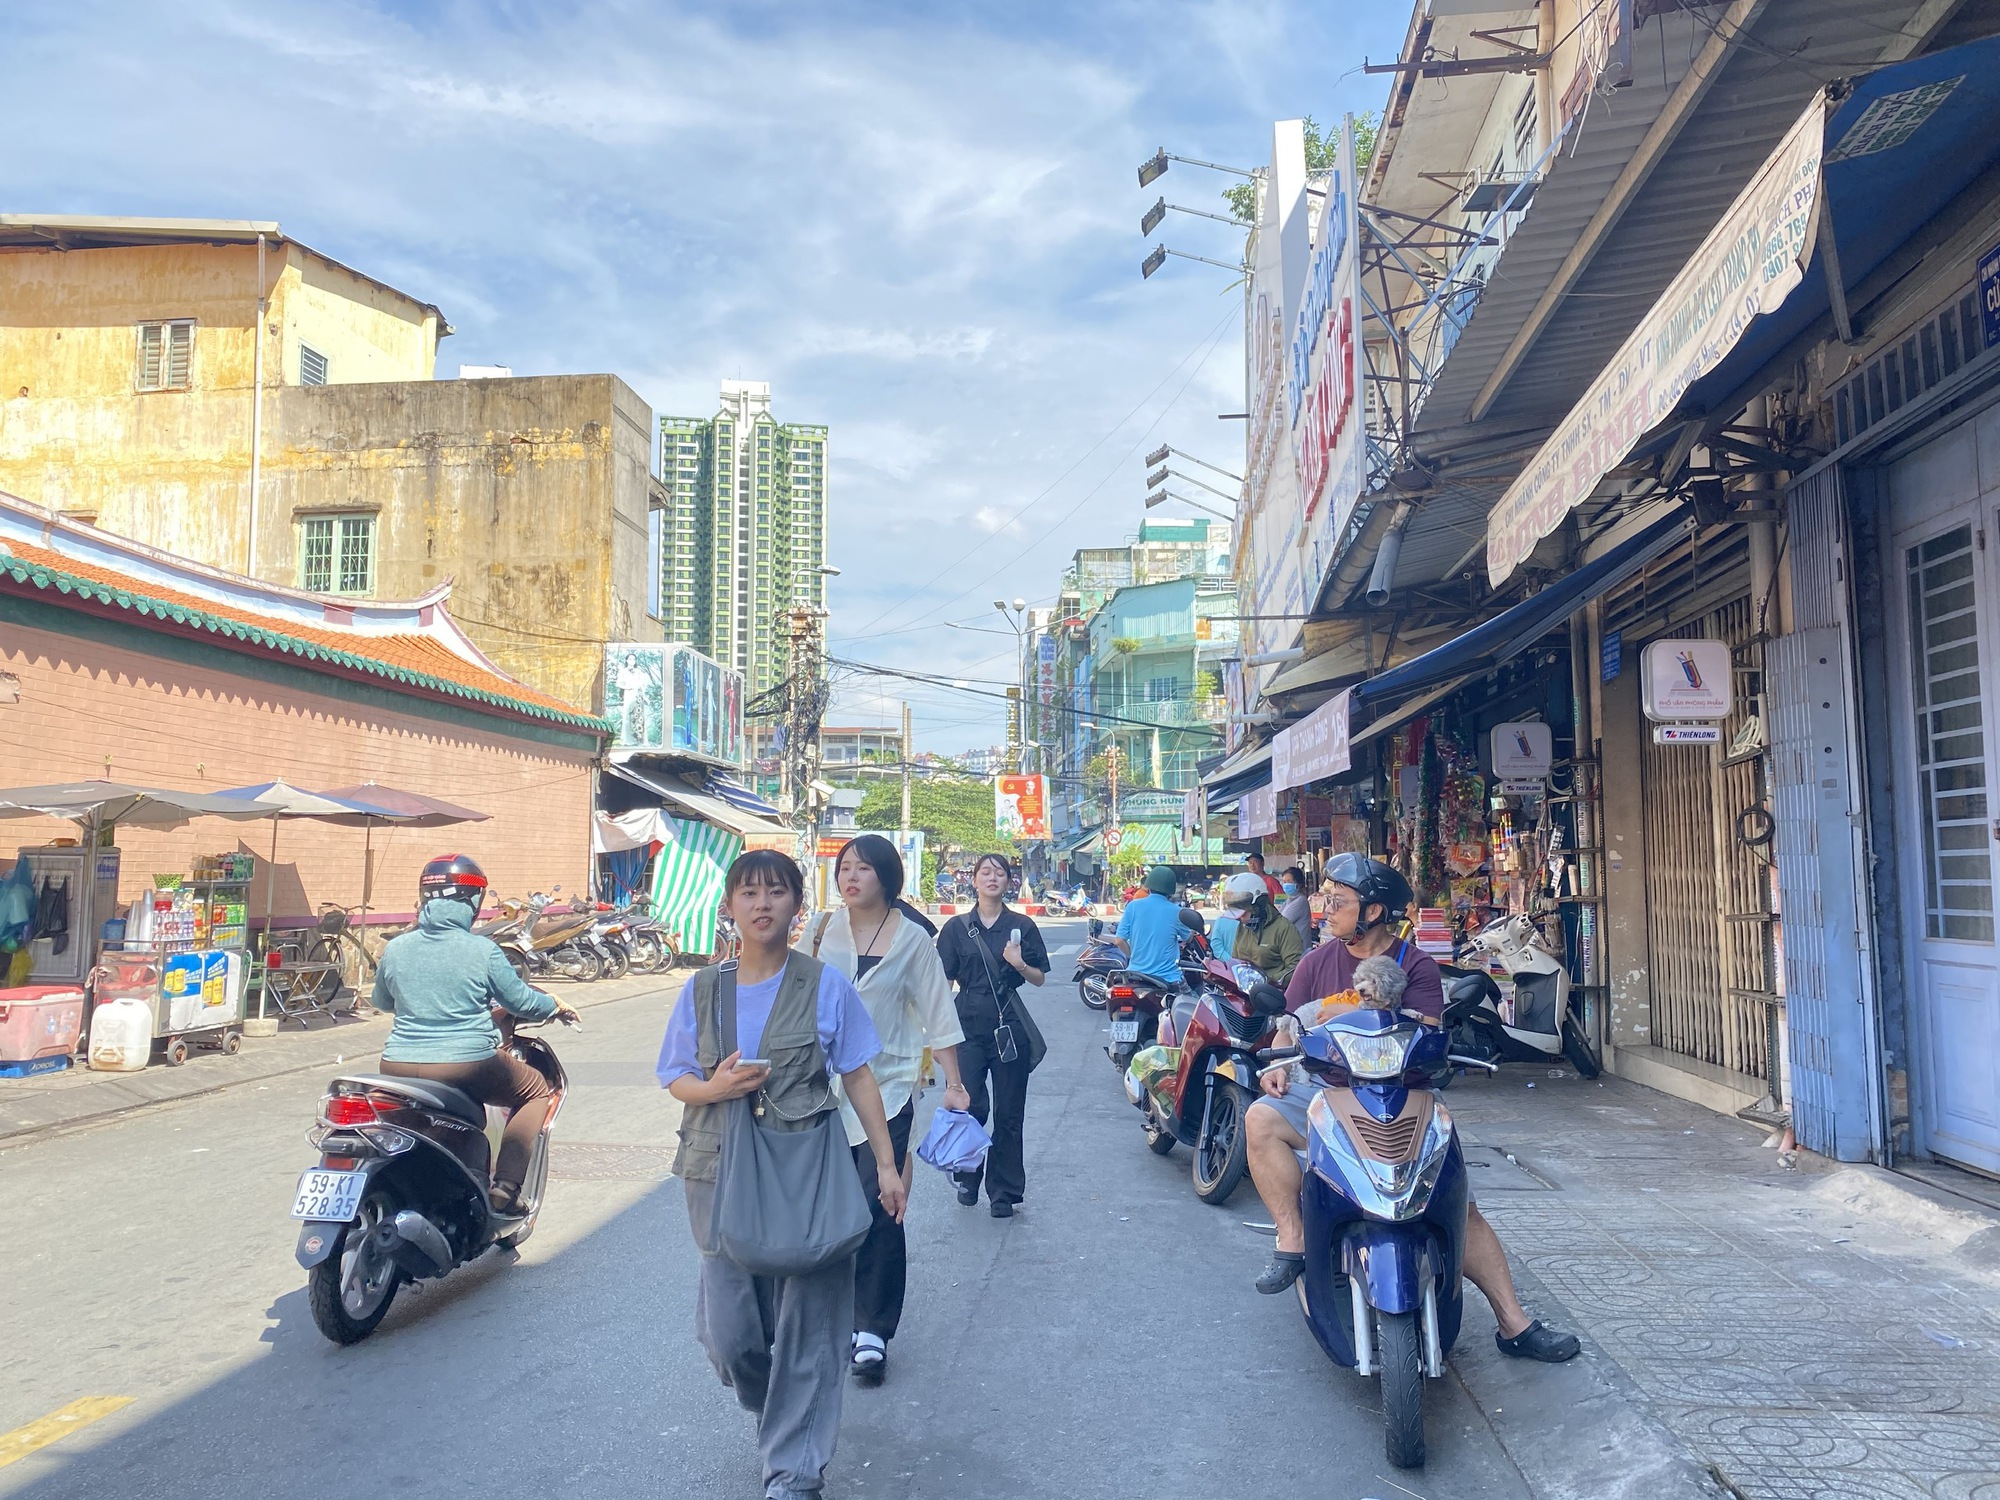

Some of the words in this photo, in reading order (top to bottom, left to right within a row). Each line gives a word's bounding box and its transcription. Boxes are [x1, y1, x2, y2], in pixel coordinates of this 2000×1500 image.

[1802, 156, 1818, 177] ĐỘN
[1793, 173, 1817, 210] PHÁ
[1552, 448, 1560, 473] TY
[1561, 425, 1581, 462] TNHH
[1582, 408, 1593, 437] SX
[1599, 388, 1612, 418] TM
[1619, 362, 1632, 392] DV
[1640, 337, 1652, 371] VT
[1571, 380, 1653, 501] BÌNH
[35, 1060, 56, 1072] pepsi
[309, 1174, 355, 1195] 59-K1
[296, 1196, 356, 1217] 528.35
